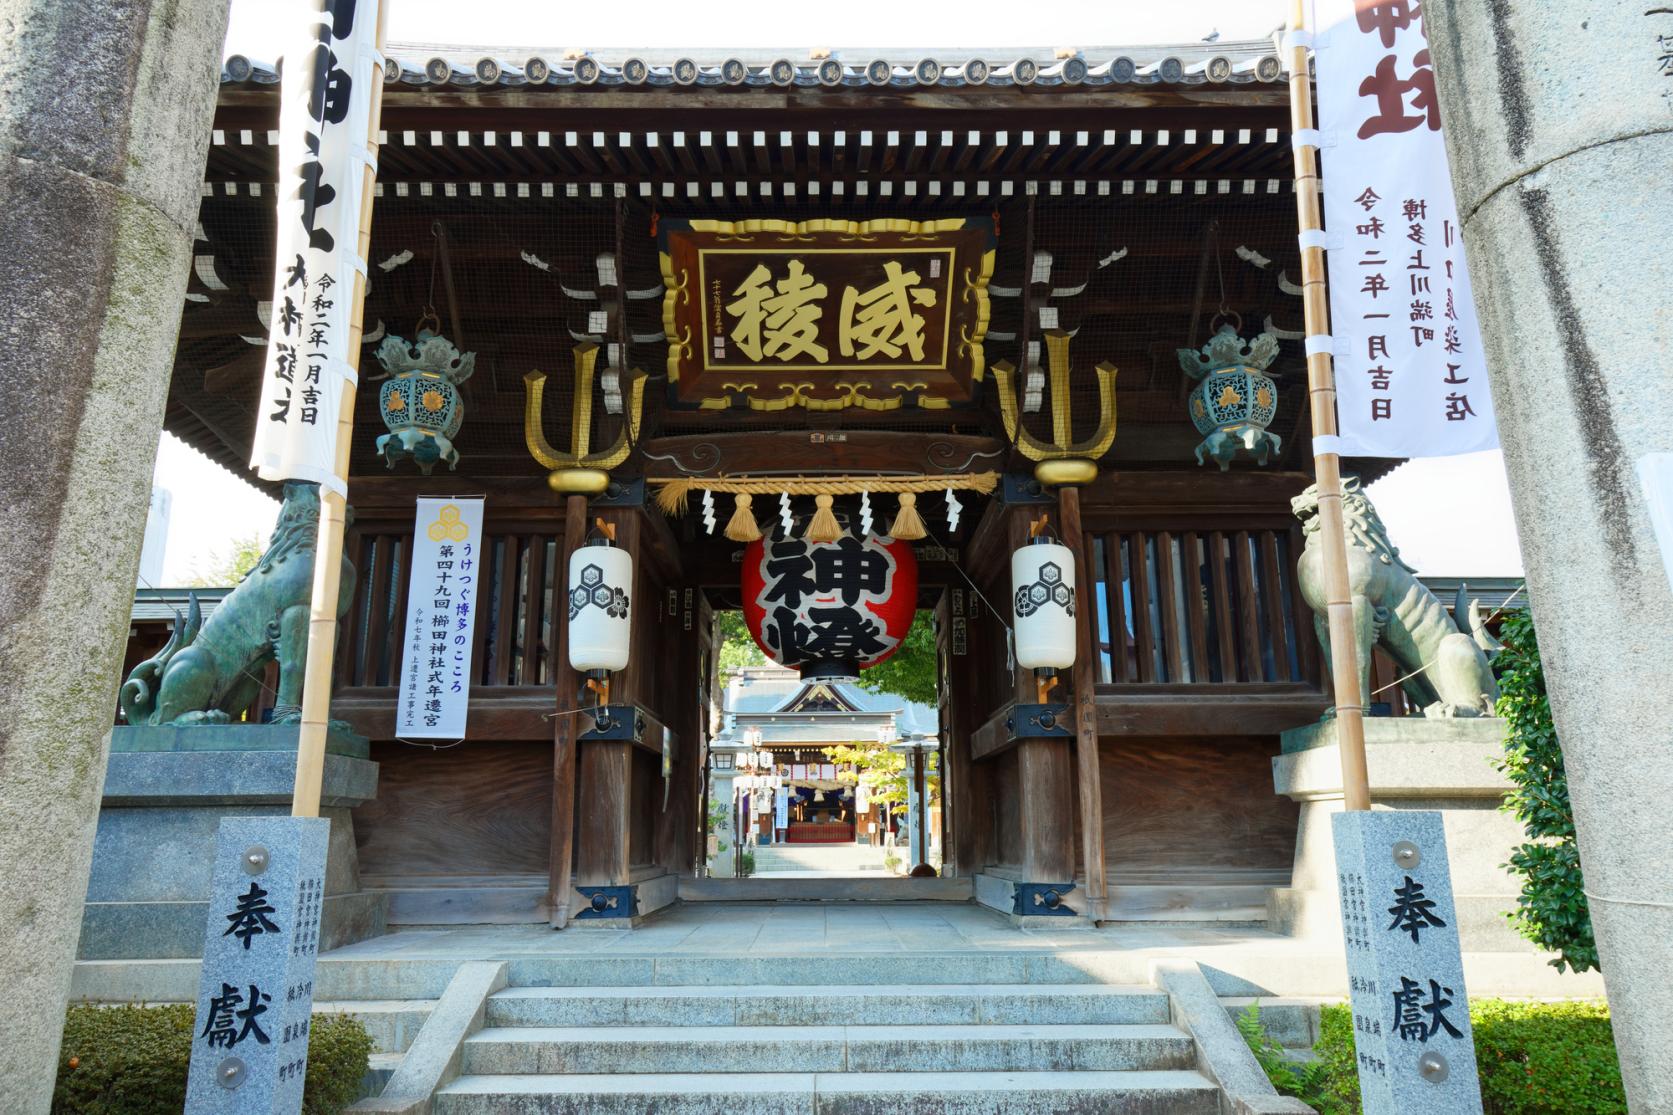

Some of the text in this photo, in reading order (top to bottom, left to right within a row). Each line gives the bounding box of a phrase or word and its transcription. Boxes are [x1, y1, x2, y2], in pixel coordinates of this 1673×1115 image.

[299, 272, 337, 426] 令和二年一月吉日
[725, 259, 936, 363] 威稜
[412, 608, 423, 652] 令和七年秋
[423, 545, 454, 727] 第四十九回 櫛田神社式年遷宮
[450, 543, 474, 693] うけつぐ博多のこころ
[201, 881, 281, 1050] 奉獻
[1388, 875, 1464, 1044] 奉獻
